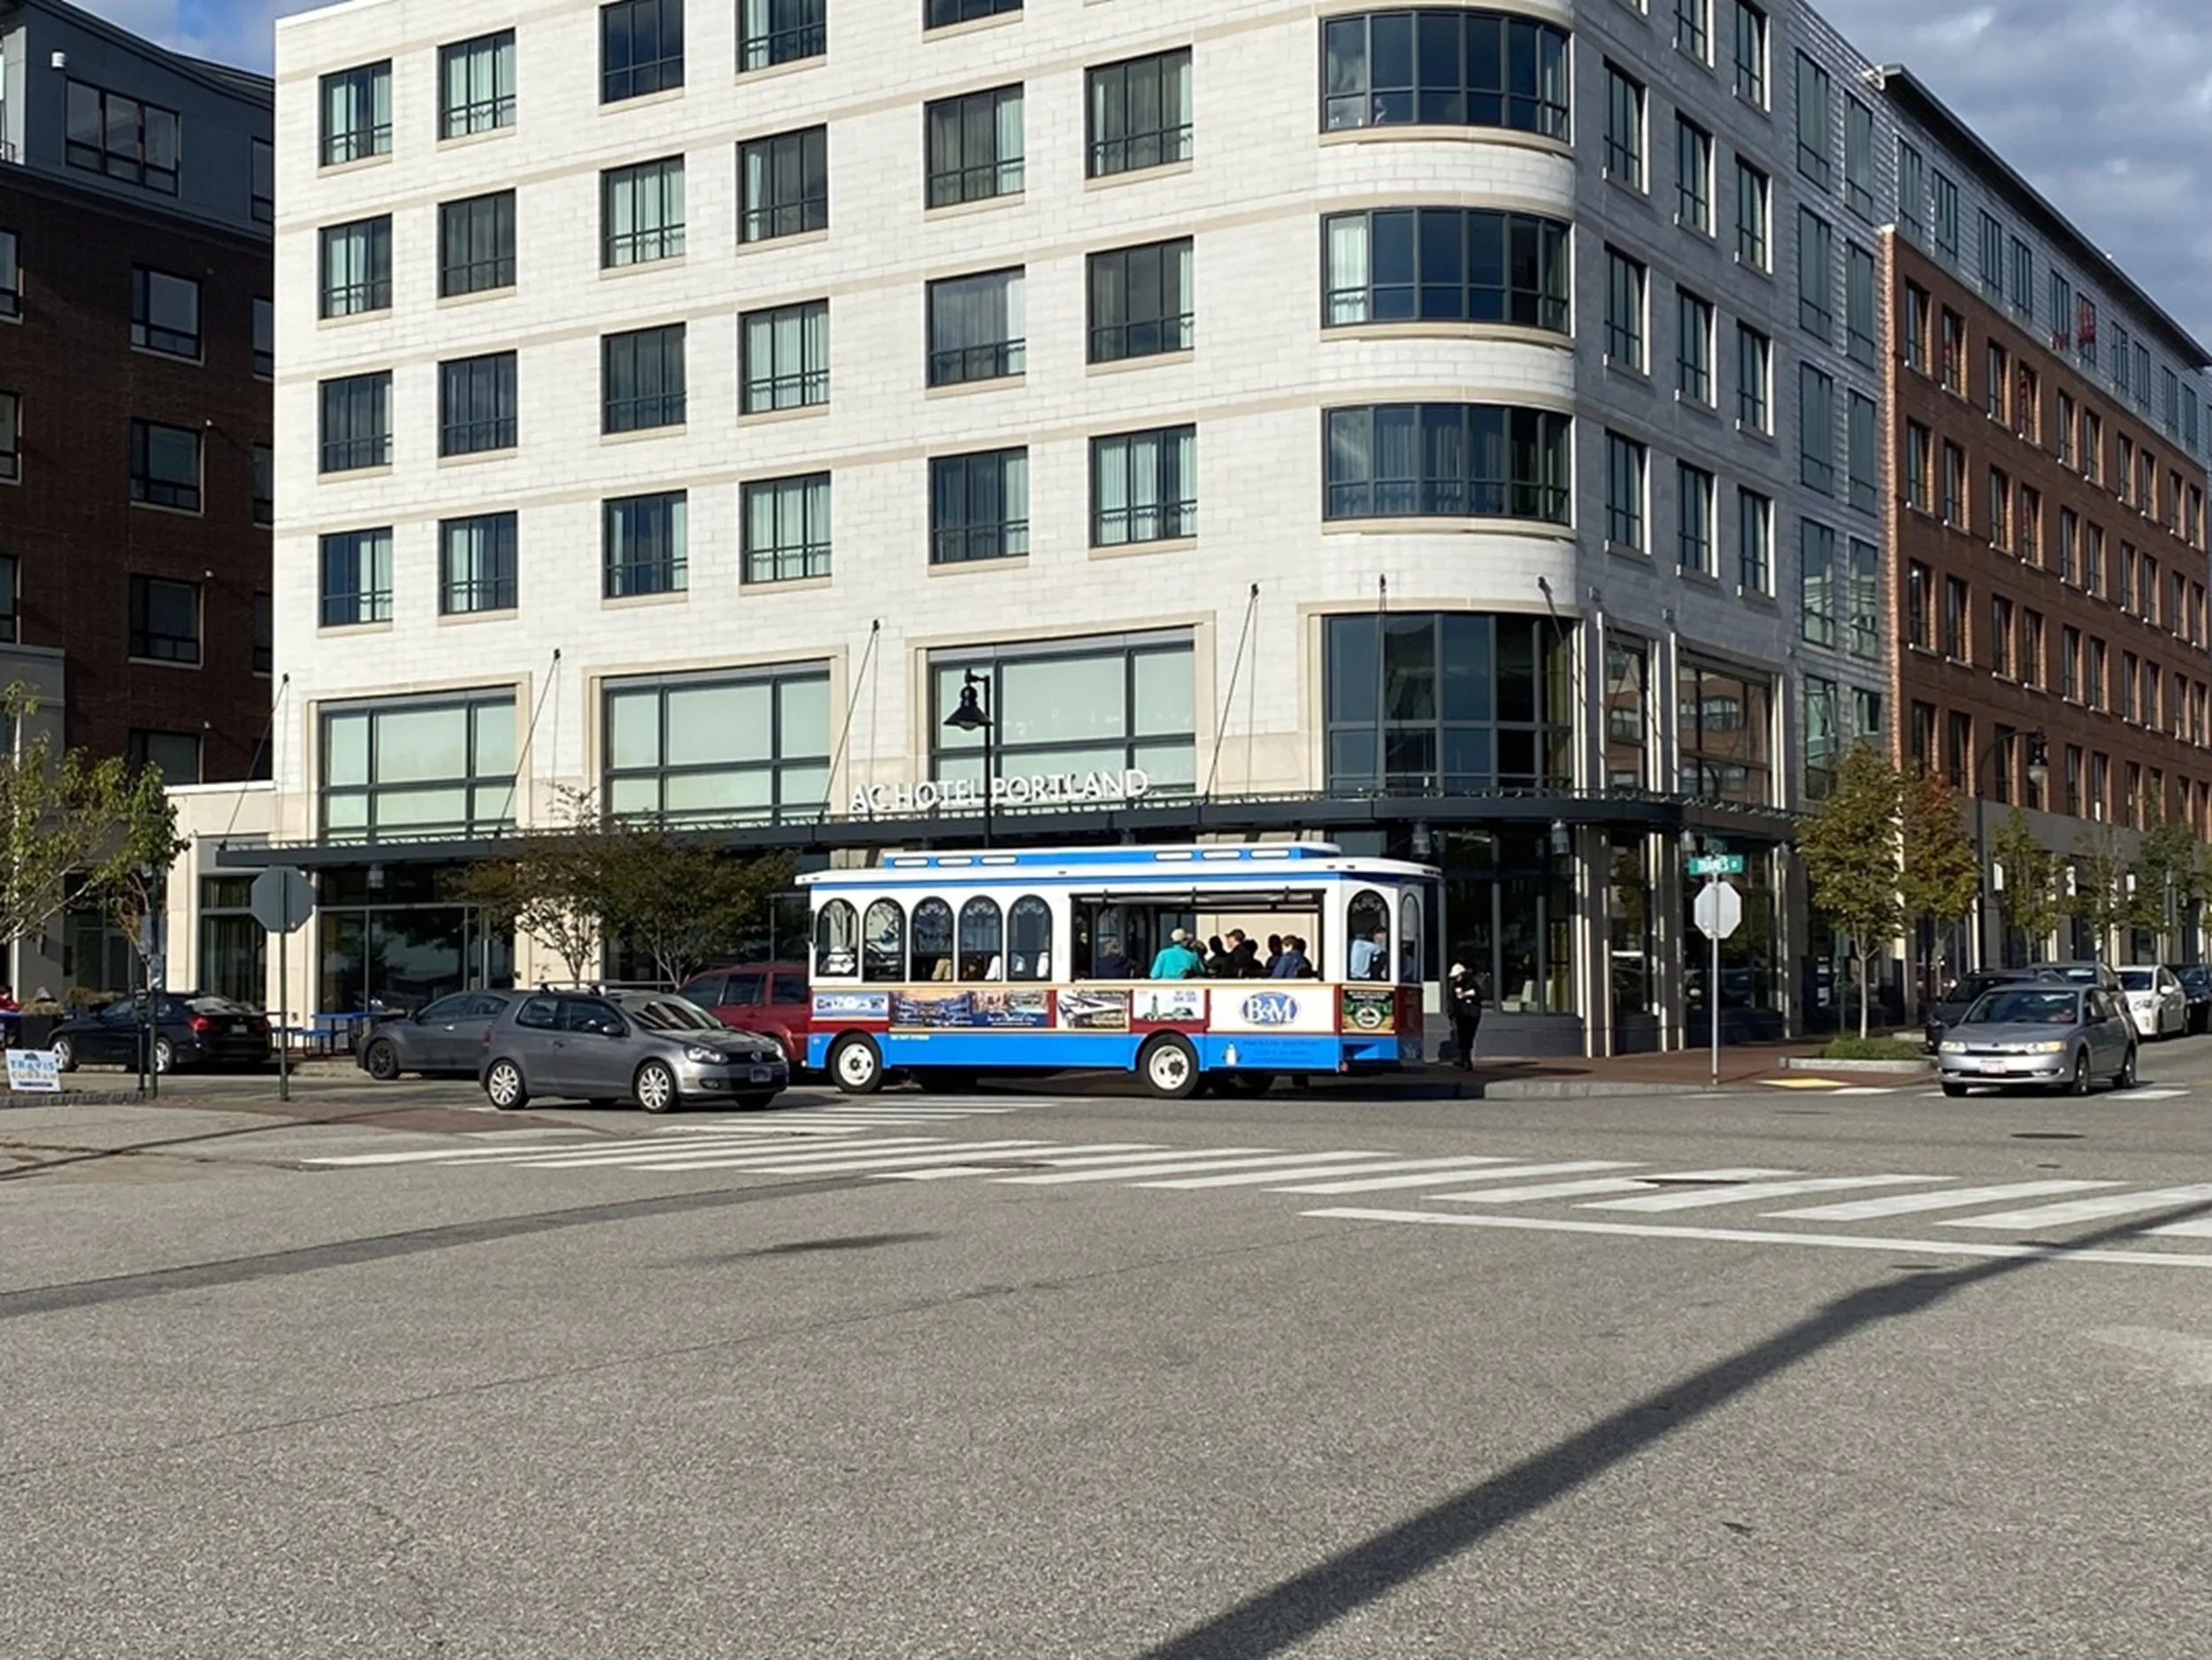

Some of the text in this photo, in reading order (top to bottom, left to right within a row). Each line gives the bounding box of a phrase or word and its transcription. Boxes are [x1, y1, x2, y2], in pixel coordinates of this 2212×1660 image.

[849, 768, 1150, 811] AC HOTEL PORTLAND
[1248, 996, 1294, 1023] B&M
